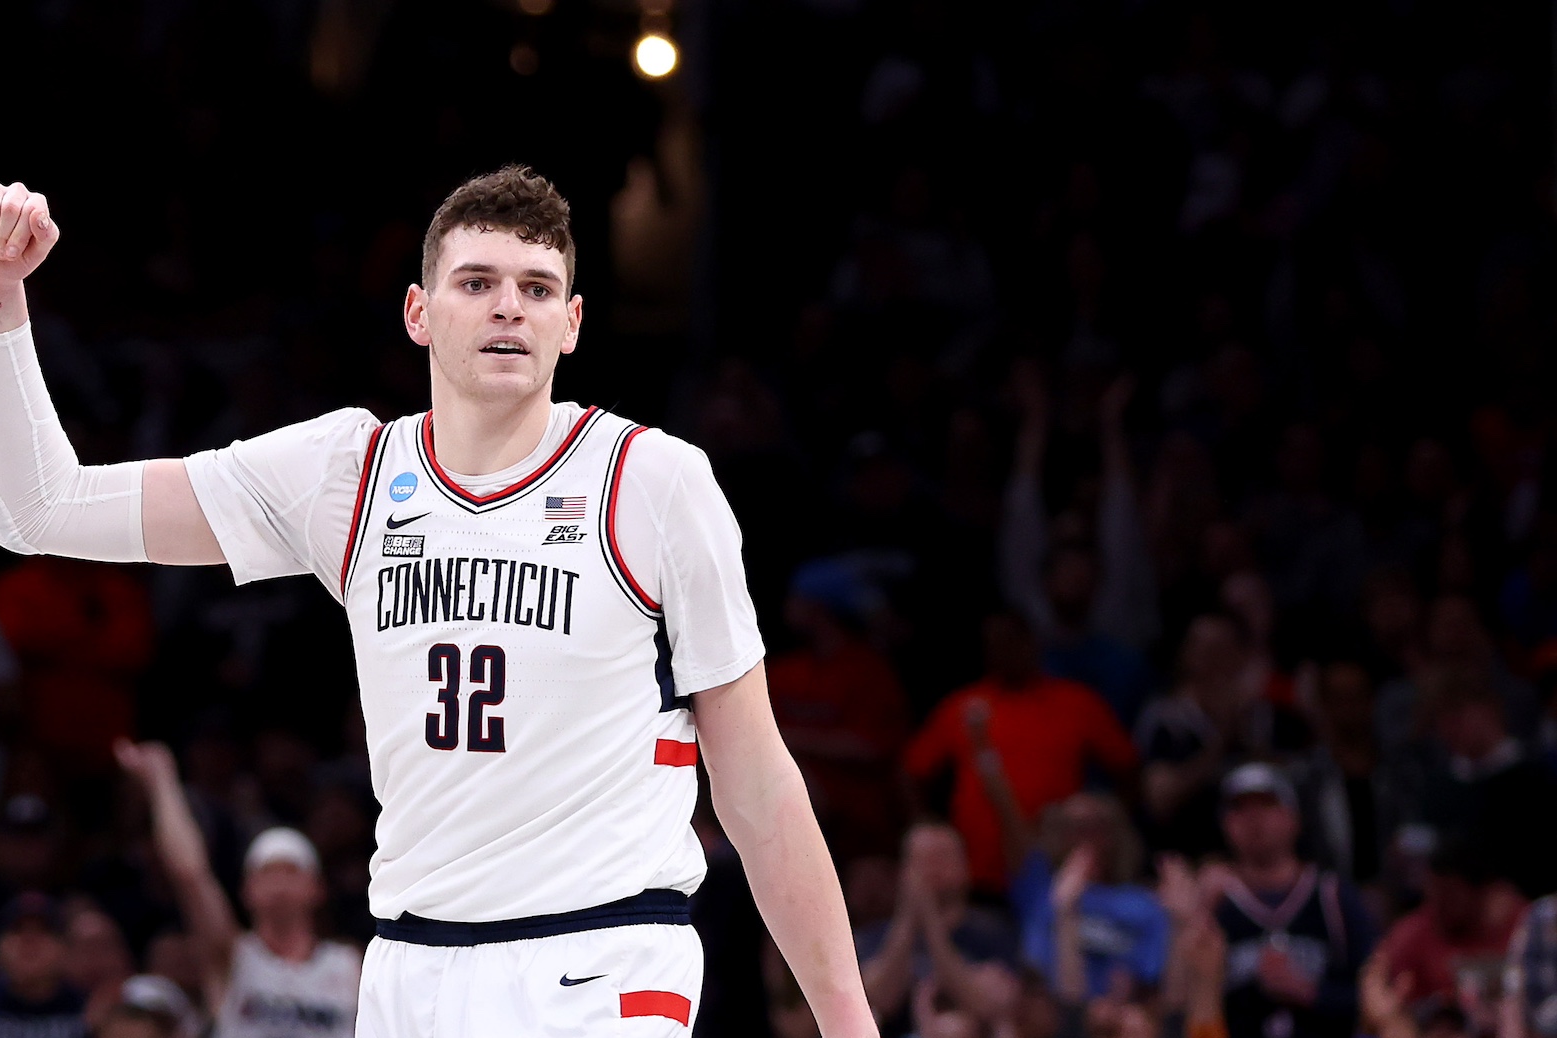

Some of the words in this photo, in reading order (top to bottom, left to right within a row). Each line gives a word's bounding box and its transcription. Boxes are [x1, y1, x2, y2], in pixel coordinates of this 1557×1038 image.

[391, 485, 415, 495] NCAA
[550, 525, 579, 534] BIG
[544, 533, 588, 542] EAST
[383, 546, 421, 555] CHANGE
[377, 557, 580, 636] CONNECTICUT
[425, 643, 507, 753] 32
